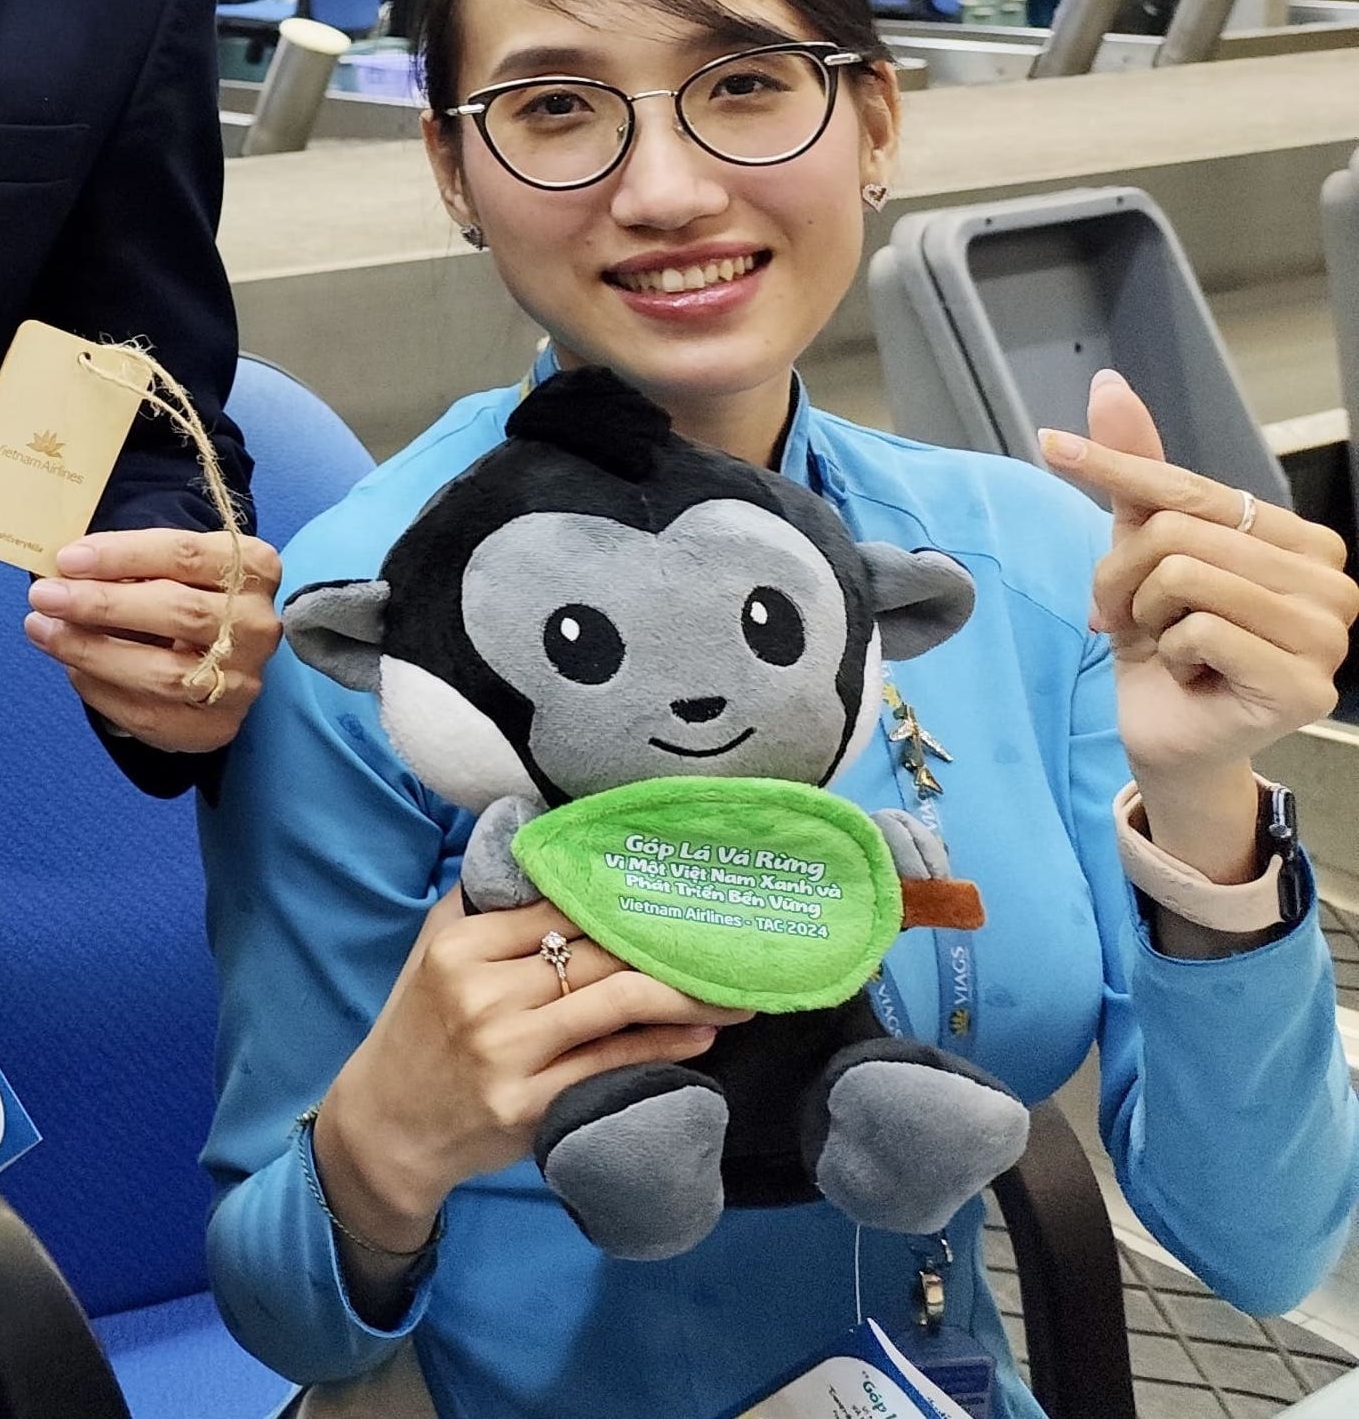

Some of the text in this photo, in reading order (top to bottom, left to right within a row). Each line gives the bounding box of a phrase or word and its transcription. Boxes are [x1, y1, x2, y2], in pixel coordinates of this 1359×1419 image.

[625, 834, 827, 882] Góp Lá Vá Rừng
[628, 856, 667, 879] Một
[669, 862, 708, 884] Việt
[710, 868, 756, 888] Nam
[759, 873, 814, 897] Xanh
[815, 883, 843, 900] và
[619, 896, 682, 918] Vietnam
[684, 907, 743, 928] Airlines
[756, 915, 784, 932] TAC
[786, 920, 830, 940] 2024
[625, 873, 673, 894] Phát
[674, 881, 726, 903] Triển
[768, 894, 822, 919] Vững
[950, 945, 969, 1005] VIAGS
